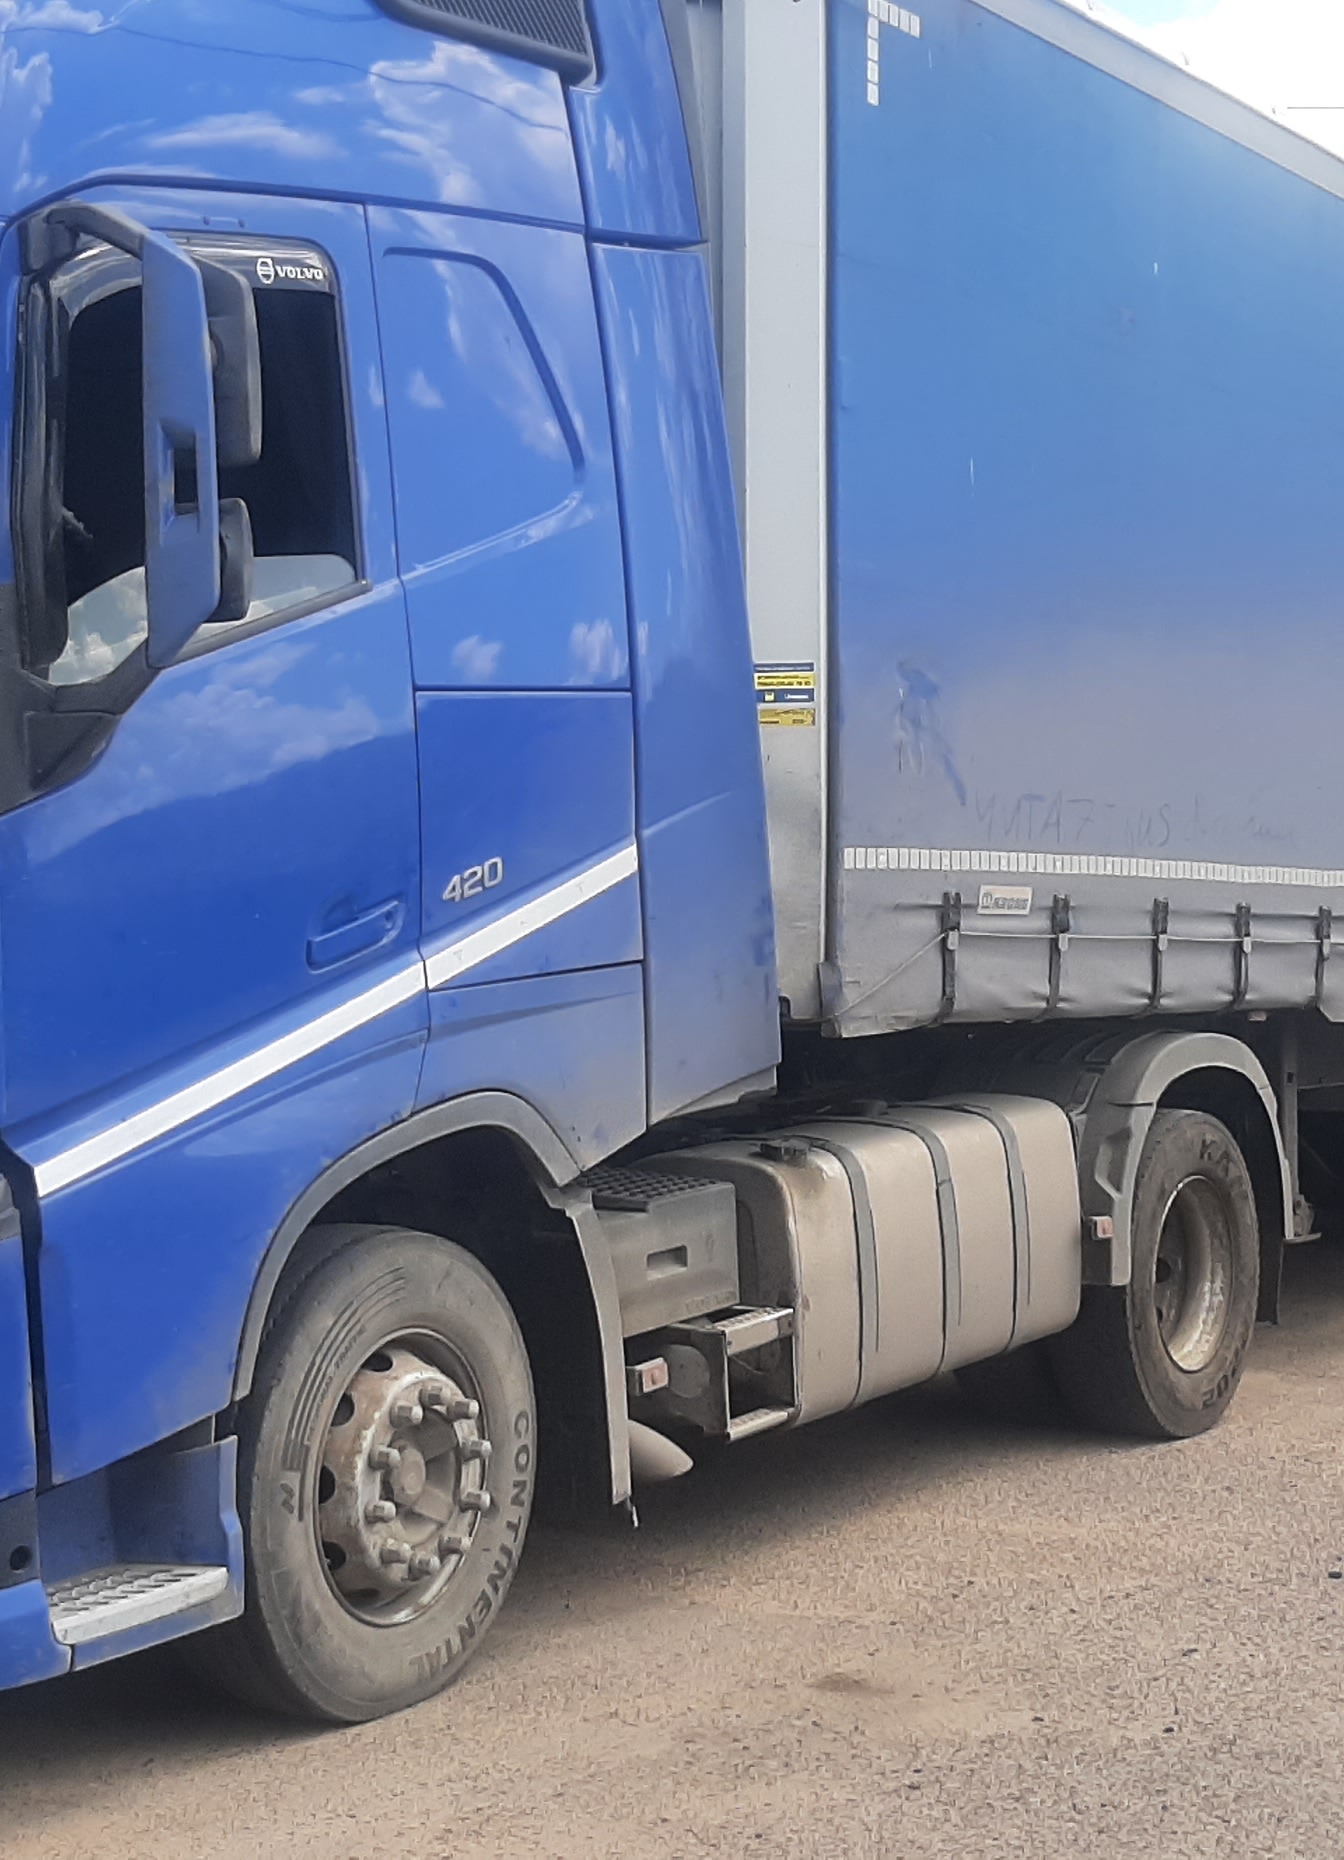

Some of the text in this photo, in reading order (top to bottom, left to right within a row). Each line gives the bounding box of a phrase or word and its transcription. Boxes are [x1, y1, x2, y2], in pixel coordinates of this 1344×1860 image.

[275, 264, 324, 279] VOLVO
[442, 856, 503, 902] 420
[409, 1410, 531, 1681] CONTINENTAL
